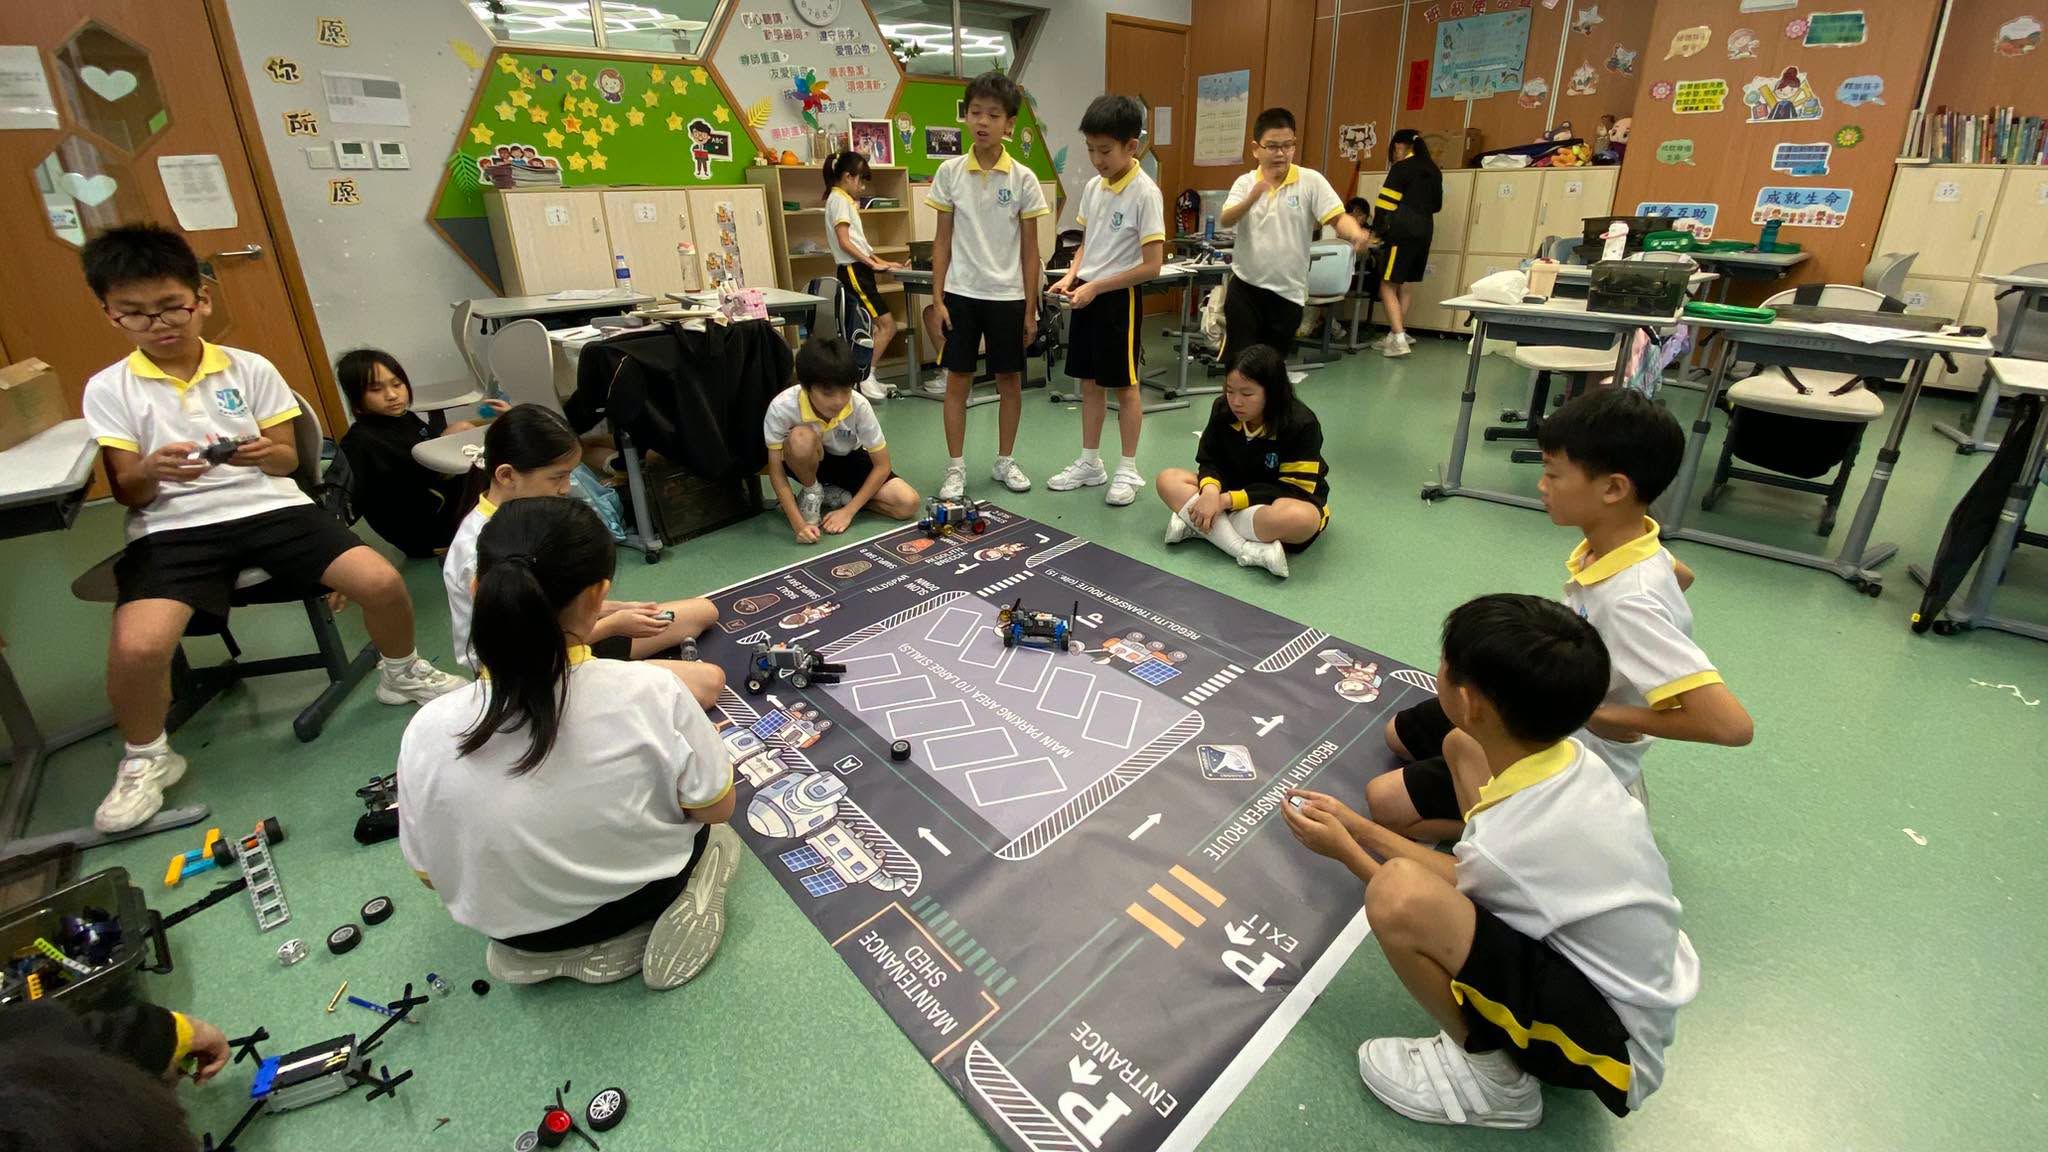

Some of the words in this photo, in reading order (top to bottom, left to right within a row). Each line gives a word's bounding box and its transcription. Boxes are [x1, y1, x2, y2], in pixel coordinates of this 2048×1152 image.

[267, 59, 299, 80] 你
[287, 113, 317, 133] 所
[1764, 190, 1842, 206] 成就生命
[866, 574, 911, 594] FELDSPAR
[903, 582, 929, 597] SLOW
[1077, 581, 1106, 599] ROUTE
[1105, 593, 1151, 620] TRANSFER
[1150, 614, 1201, 641] REGOLITH
[896, 642, 934, 666] STALLS)
[929, 662, 960, 683] LARGE
[973, 690, 1001, 715] AREA
[996, 708, 1044, 742] PARKING
[1039, 734, 1075, 759] MAIN
[839, 759, 856, 770] A
[1289, 739, 1339, 782] REGOLITH
[1239, 777, 1298, 828] TRANSFER
[1202, 821, 1248, 862] ROUTE
[1242, 914, 1299, 954] EXIT
[904, 944, 948, 989] SHED
[1221, 949, 1286, 993] P
[858, 930, 958, 1036] MAINTENANCE
[1070, 1020, 1179, 1119] ENTRANCE
[1057, 1090, 1133, 1148] P
